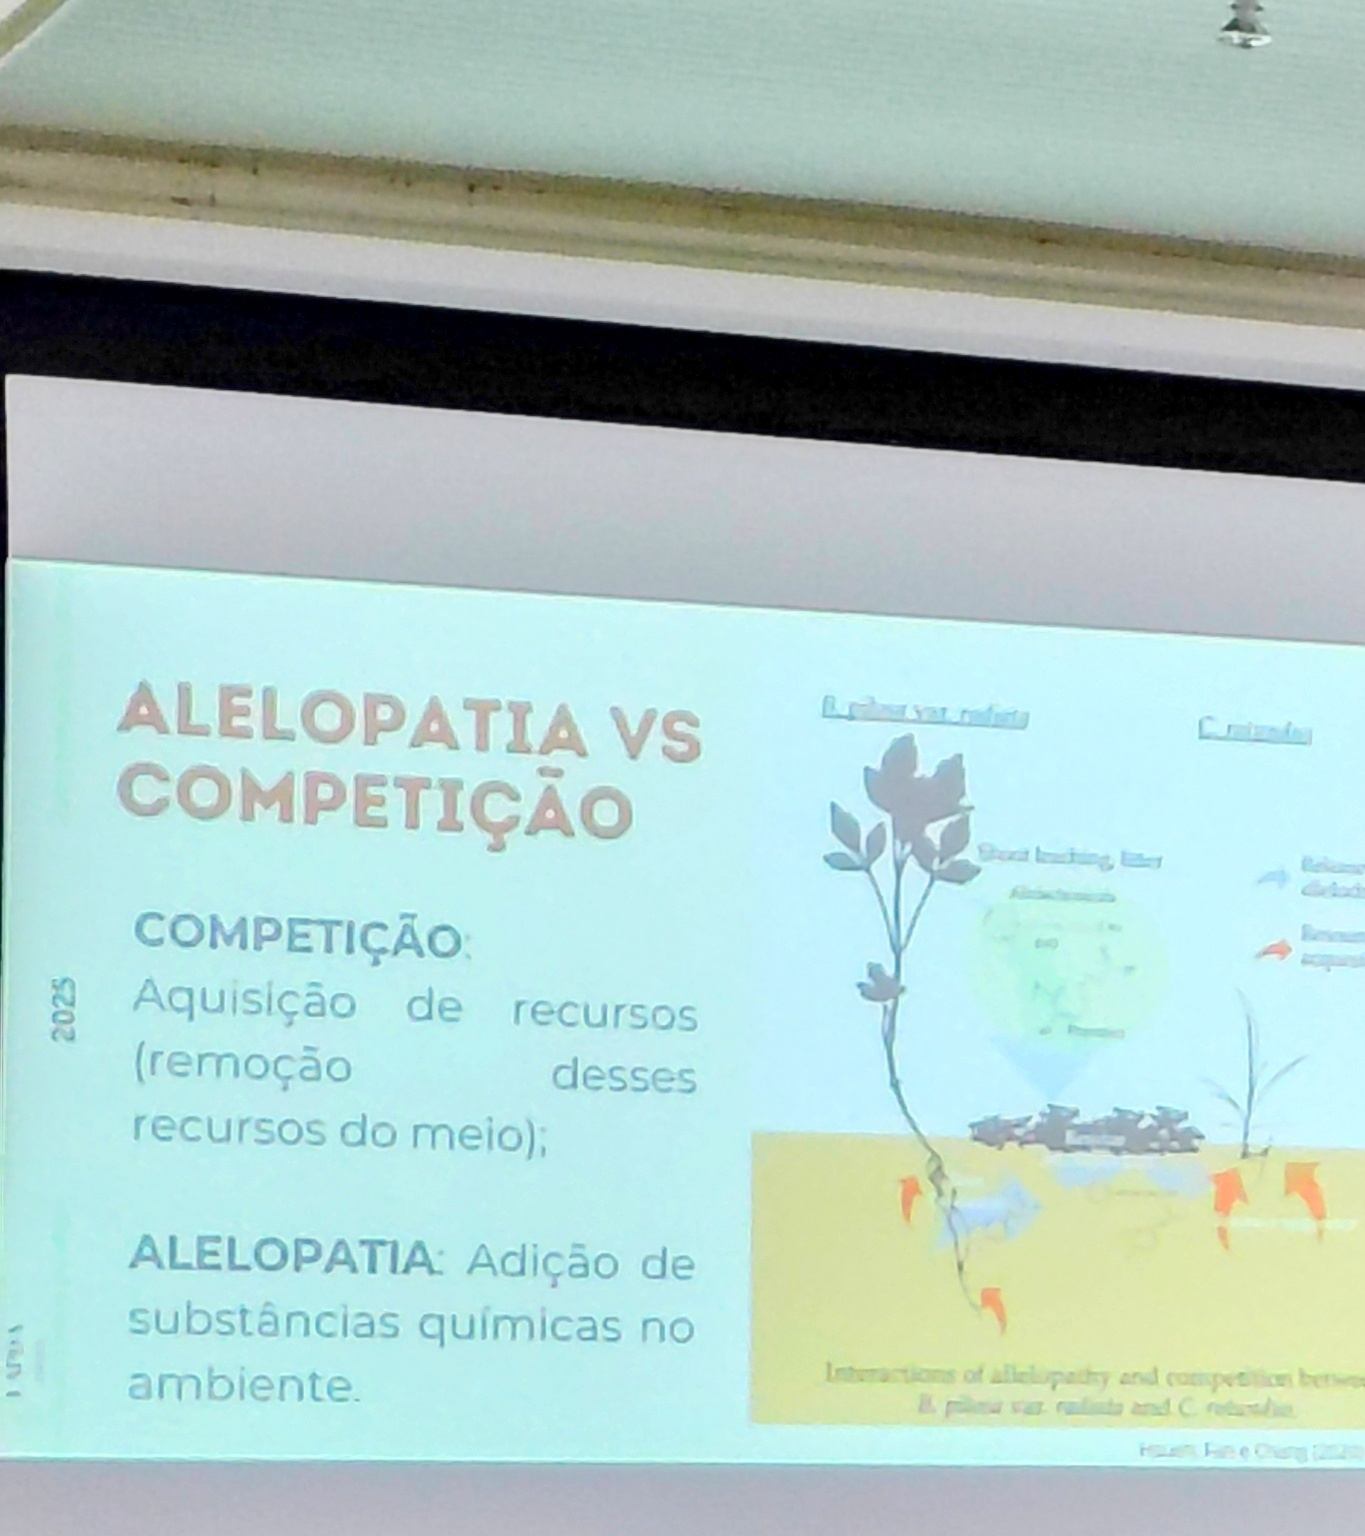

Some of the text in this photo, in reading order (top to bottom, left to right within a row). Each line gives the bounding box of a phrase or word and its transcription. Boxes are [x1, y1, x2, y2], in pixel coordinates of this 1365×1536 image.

[116, 679, 703, 763] ALELOPATIA VS
[116, 761, 634, 853] COMPETIÇÃO
[134, 911, 473, 967] COMPETIÇÃO:
[132, 975, 699, 1032] Aquisição de recursos
[134, 1040, 698, 1094] (remoção desses
[132, 1112, 548, 1161] recursos do meio);
[128, 1233, 696, 1289] ALELOPATIA: Adição de
[127, 1301, 695, 1349] substâncias químicas no
[127, 1365, 362, 1403] ambiente.
